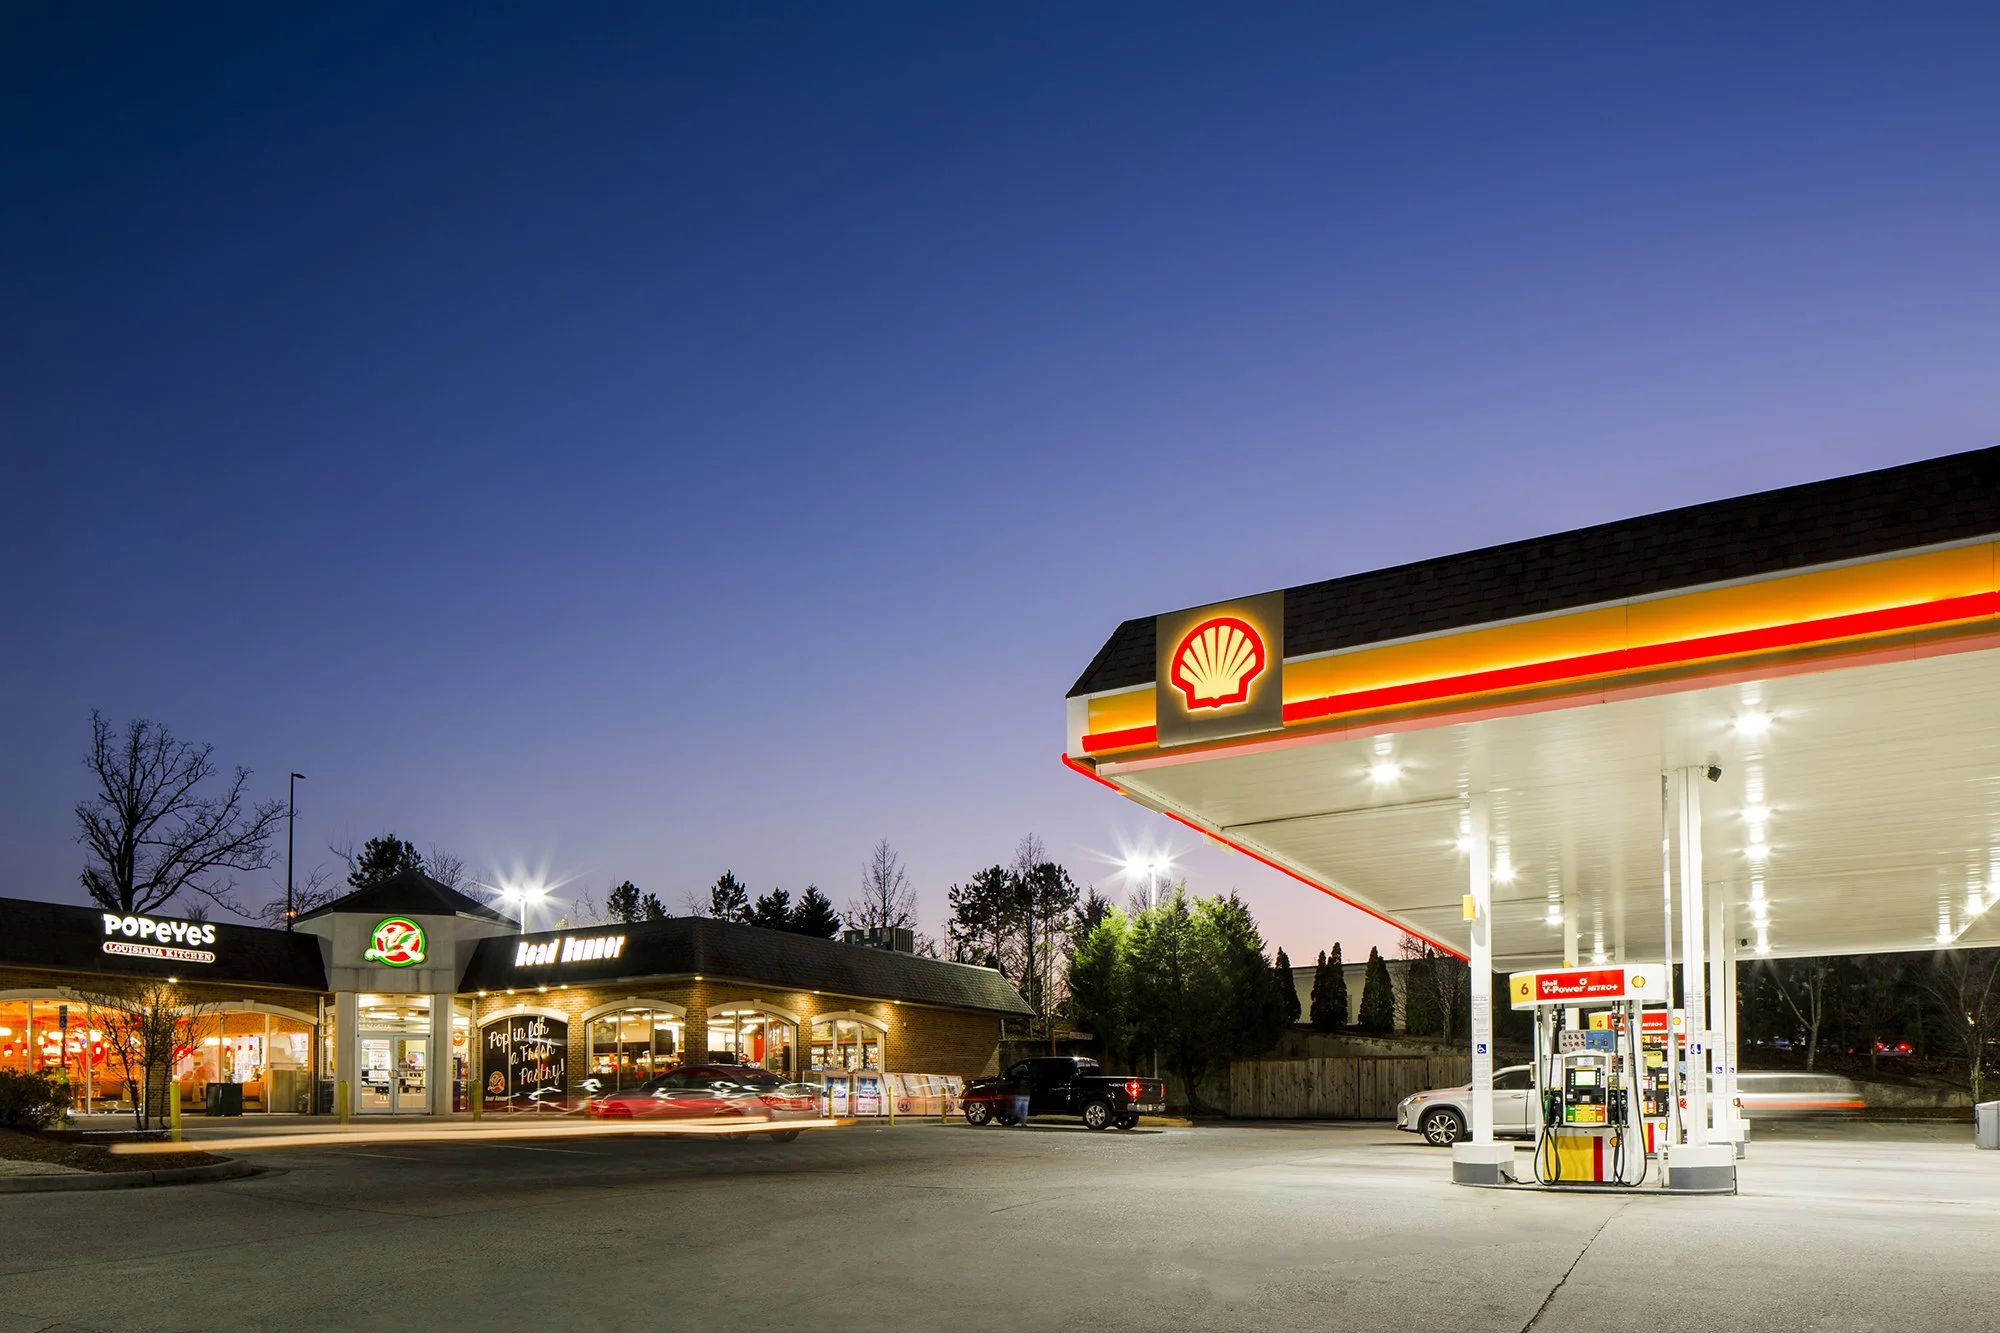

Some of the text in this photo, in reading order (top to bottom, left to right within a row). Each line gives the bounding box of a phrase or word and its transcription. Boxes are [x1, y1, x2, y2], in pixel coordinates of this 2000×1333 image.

[108, 943, 212, 961] LOUISIANA KITCHEN
[514, 936, 625, 967] Road Runner
[1520, 983, 1529, 996] 6
[1542, 983, 1619, 994] V-Power NITRO+
[1596, 1020, 1603, 1028] 4
[488, 1020, 549, 1053] Pop in for
[510, 1038, 556, 1065] a Fresh
